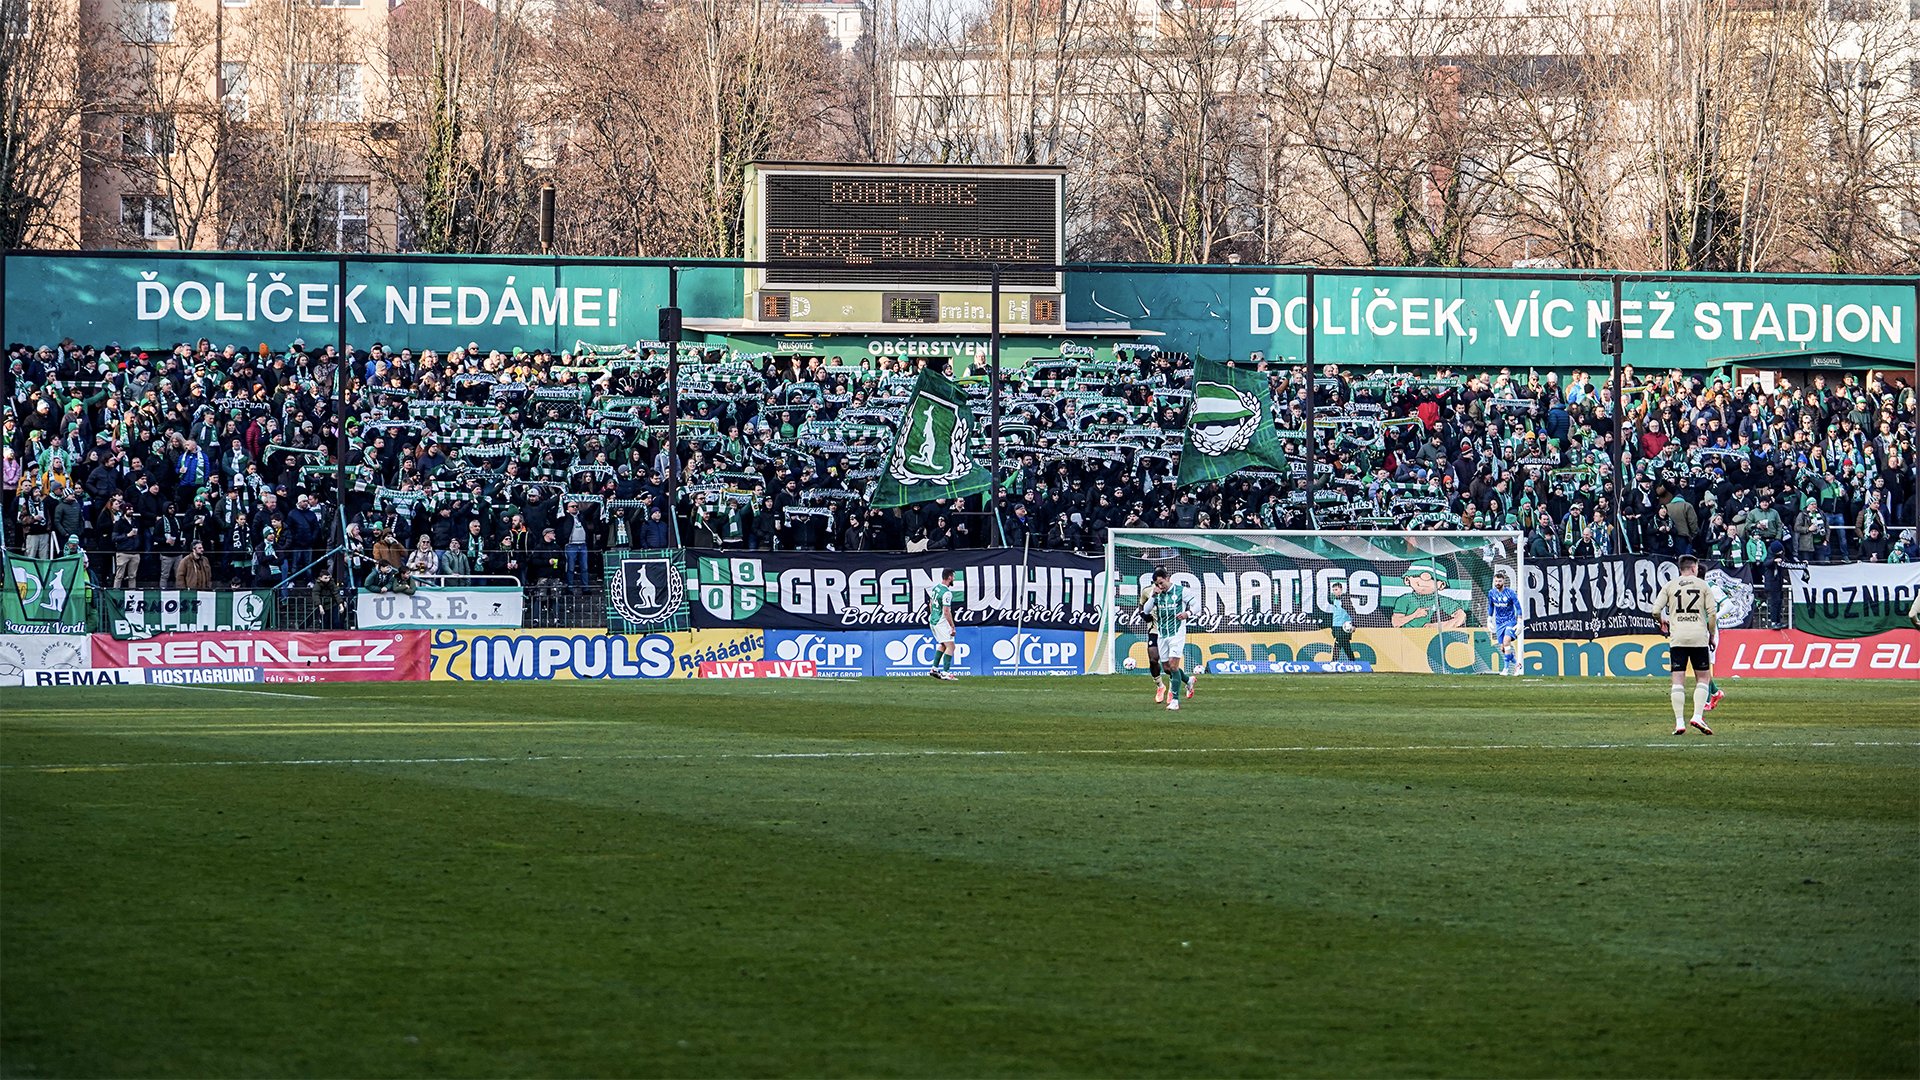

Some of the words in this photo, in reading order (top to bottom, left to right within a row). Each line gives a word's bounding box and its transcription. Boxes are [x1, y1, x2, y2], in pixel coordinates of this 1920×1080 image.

[832, 182, 977, 204] BOHEMIANS
[136, 271, 367, 323] ĎOLÍČEK
[385, 275, 618, 327] NEDÁME!
[1250, 287, 1477, 345] ĎOLÍČEK,
[1494, 290, 1574, 338] VÍC
[1587, 291, 1675, 340] NEŽ
[1694, 302, 1901, 344] STADION
[780, 567, 944, 615] GREEN
[1674, 589, 1701, 613] 12
[373, 595, 478, 621] U.R.E.
[52, 621, 85, 633] Verdi
[473, 637, 674, 679] IMPULS
[808, 636, 863, 666] ČPP
[1023, 636, 1078, 665] ČPP
[36, 671, 129, 686] REMAL
[151, 667, 256, 684] HOSTAGRUND
[265, 675, 284, 684] rály
[707, 662, 755, 678] JVC
[765, 661, 813, 678] JVC
